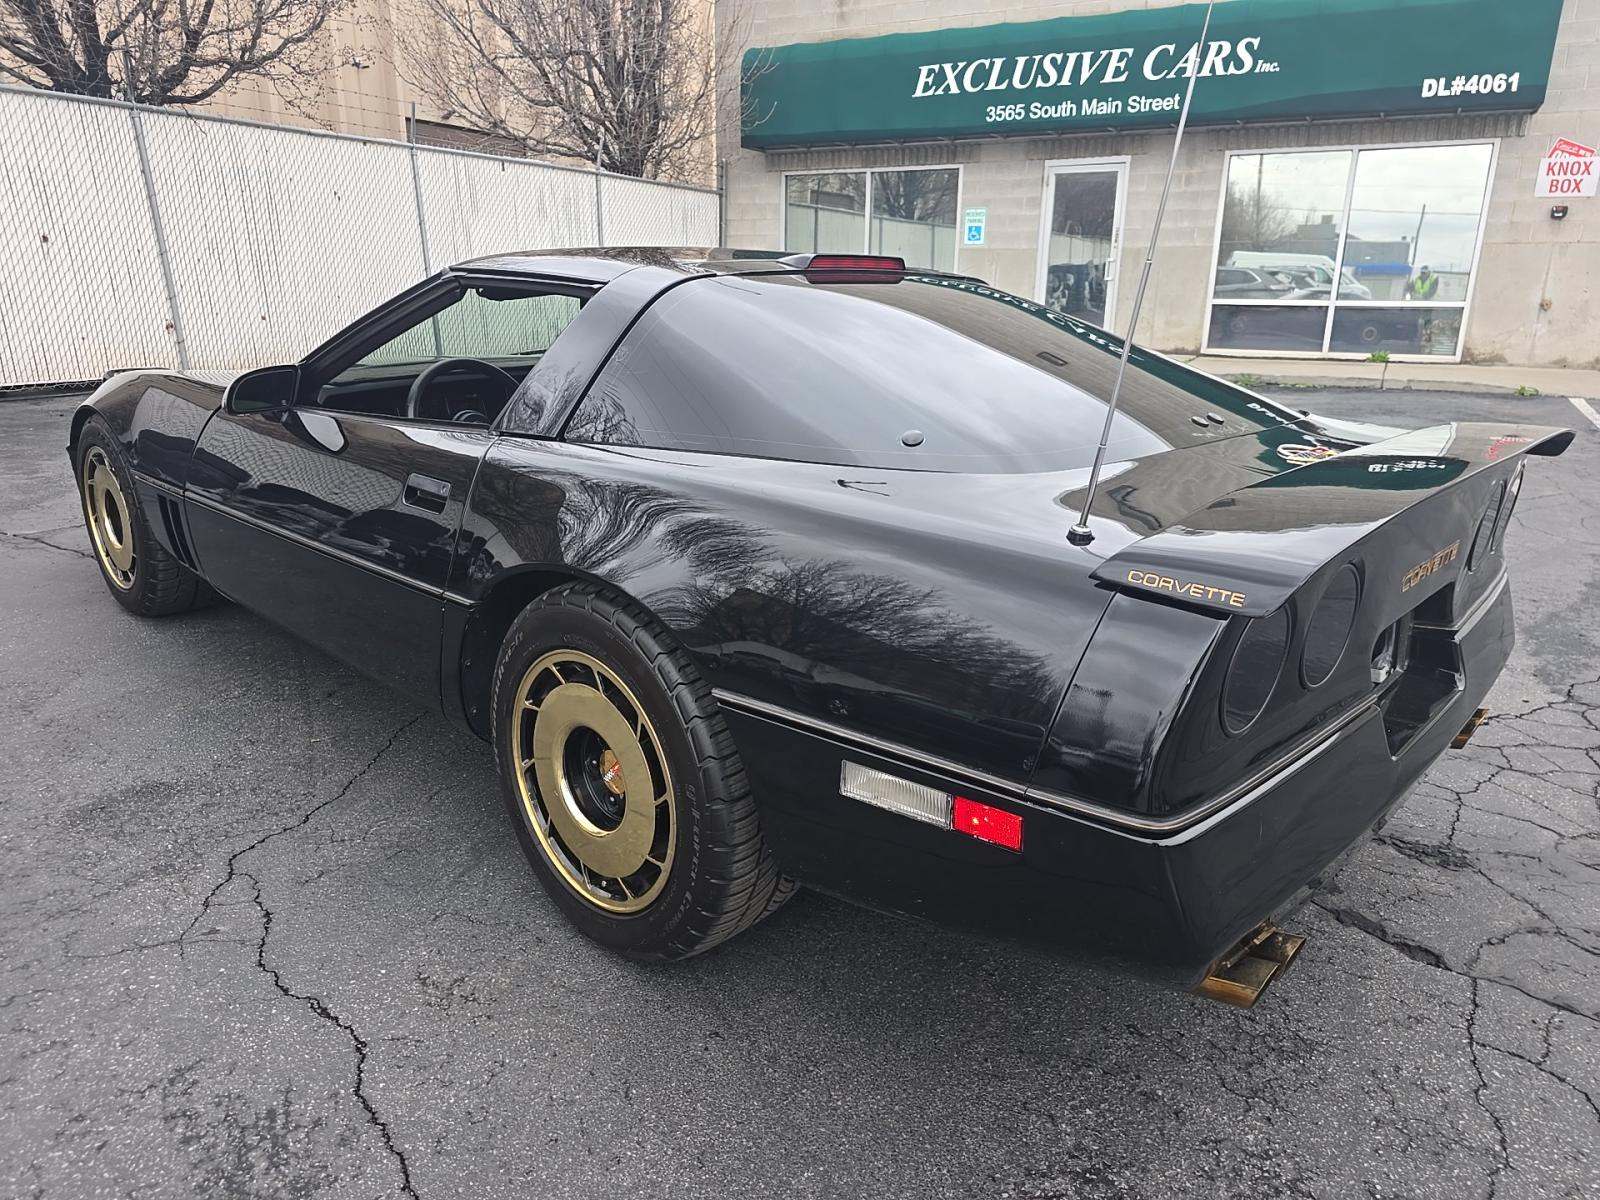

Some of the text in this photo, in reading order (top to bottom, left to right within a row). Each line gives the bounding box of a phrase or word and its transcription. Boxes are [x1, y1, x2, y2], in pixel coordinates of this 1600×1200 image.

[912, 36, 1280, 97] EXCLUSIVE CARS Inc.
[1422, 72, 1520, 98] DL#4061
[986, 92, 1180, 122] 3565 South Main Street
[1546, 160, 1593, 177] KNOX
[1548, 178, 1583, 193] BOX
[1401, 540, 1460, 593] CORVETTE
[1127, 570, 1246, 607] CORVETTE
